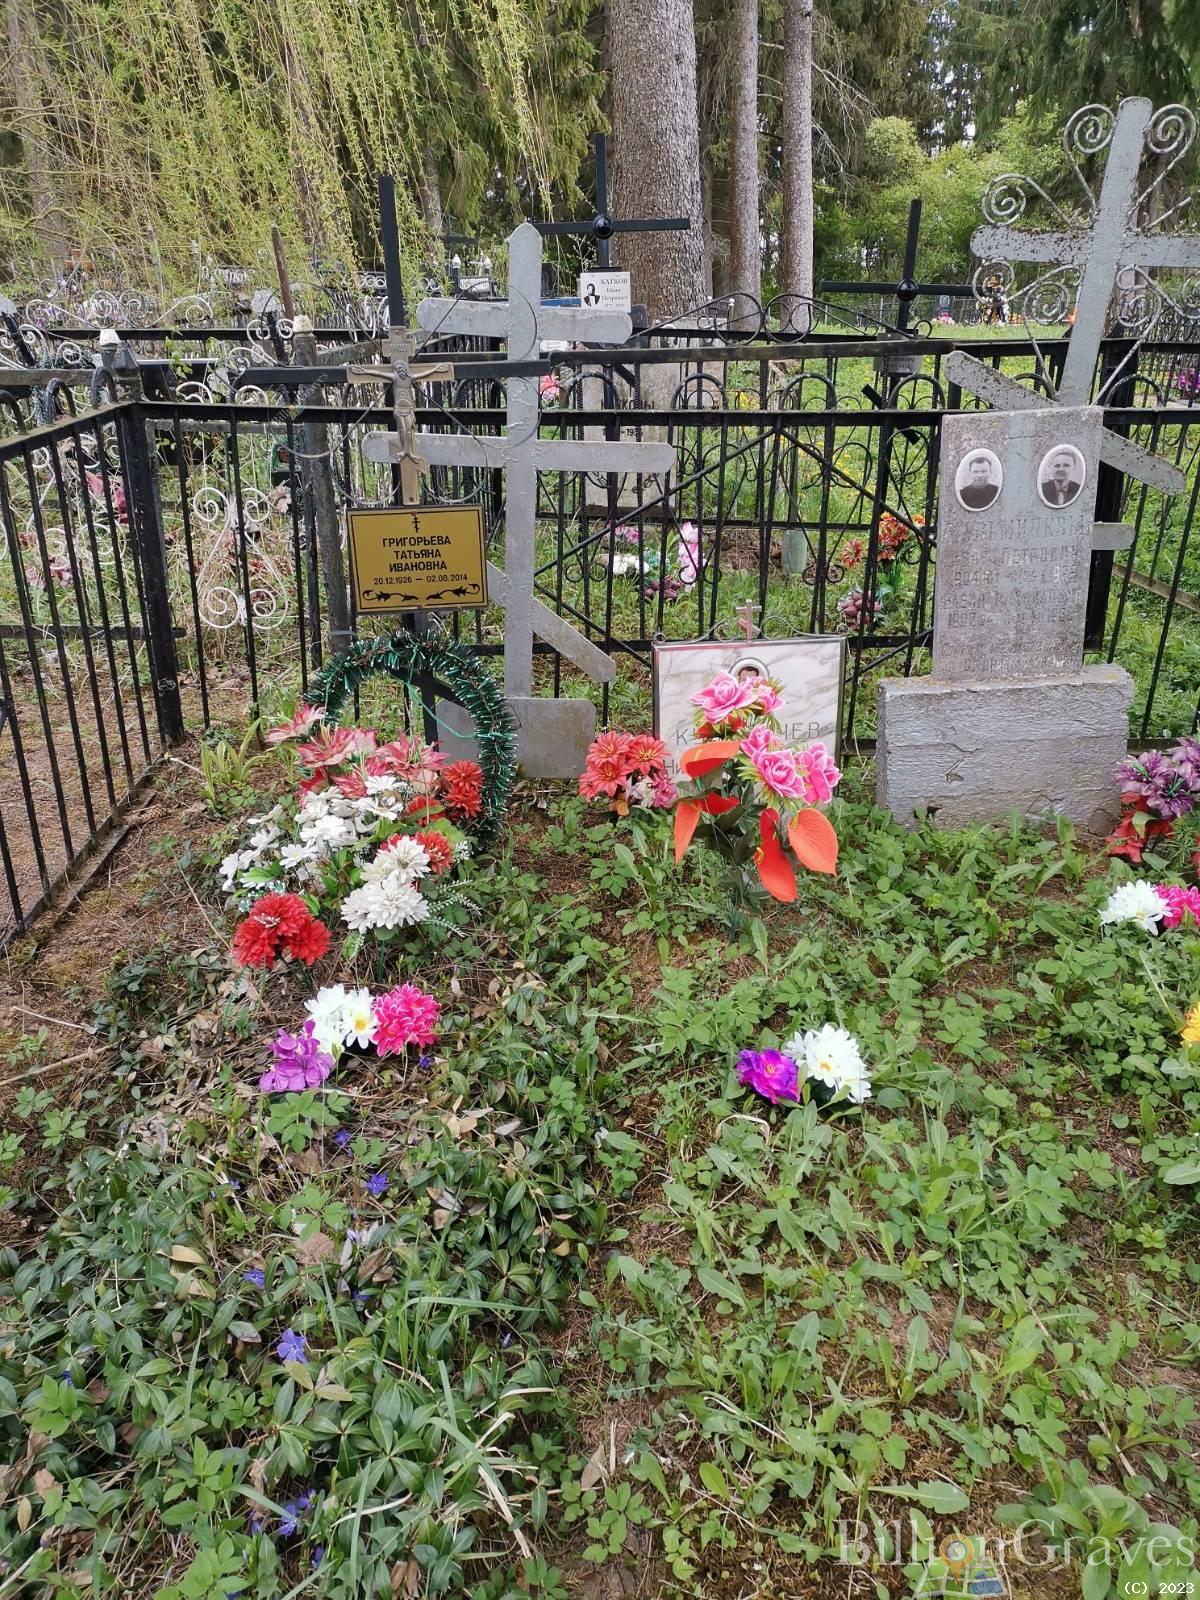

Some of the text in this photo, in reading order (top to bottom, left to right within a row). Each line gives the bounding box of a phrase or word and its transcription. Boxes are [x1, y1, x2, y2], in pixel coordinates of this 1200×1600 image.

[382, 535, 452, 548] ГРИГОРЬЕВА
[393, 549, 442, 560] ТАТЬЯНА
[389, 561, 448, 573] ИВАНОВНА
[373, 576, 413, 586] 20.12.1926
[426, 574, 468, 583] 02.08.2014
